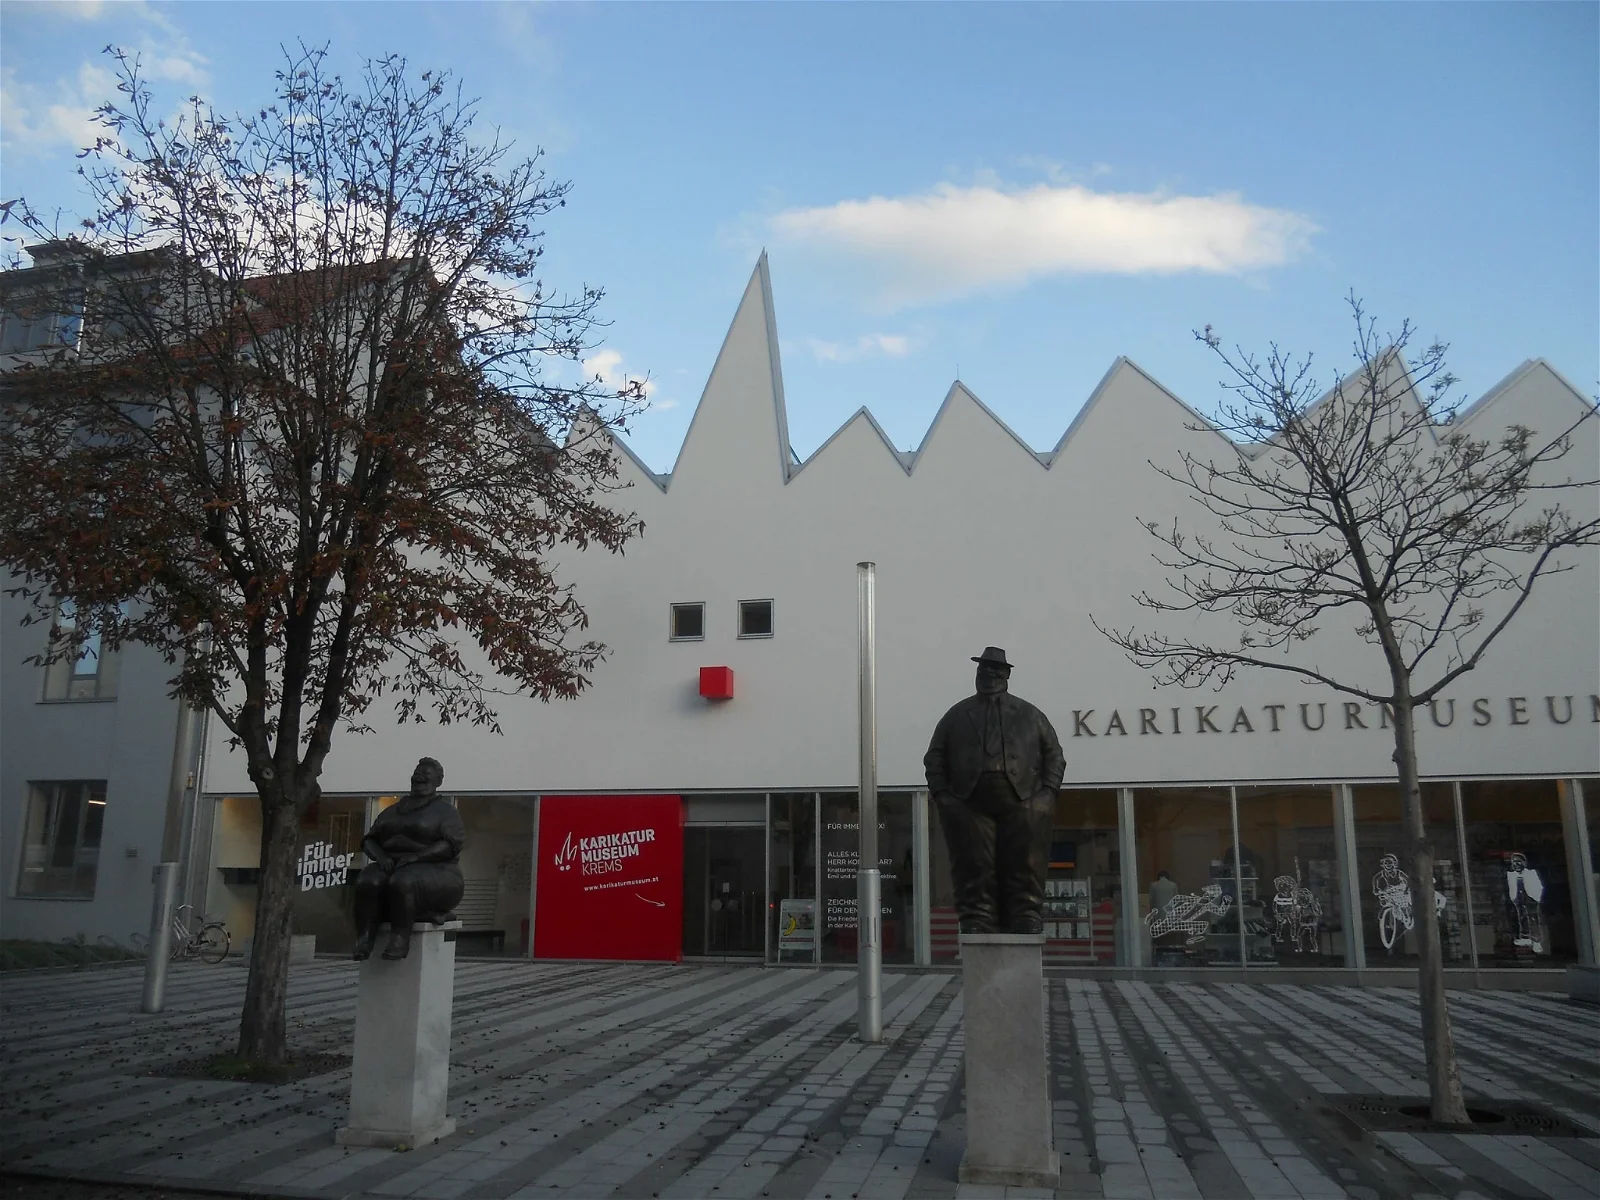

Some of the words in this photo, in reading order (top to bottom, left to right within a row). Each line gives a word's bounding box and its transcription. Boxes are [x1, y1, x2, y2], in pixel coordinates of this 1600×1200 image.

[828, 822, 842, 830] FÜR
[580, 828, 656, 850] KARIKATUR
[304, 841, 333, 861] Für
[581, 843, 640, 863] MUSEUM
[297, 852, 354, 876] immer
[582, 858, 623, 876] KREMS
[301, 866, 347, 892] Deix!
[584, 876, 659, 891] www.karikaturmuseum.at
[828, 906, 843, 914] FÜR
